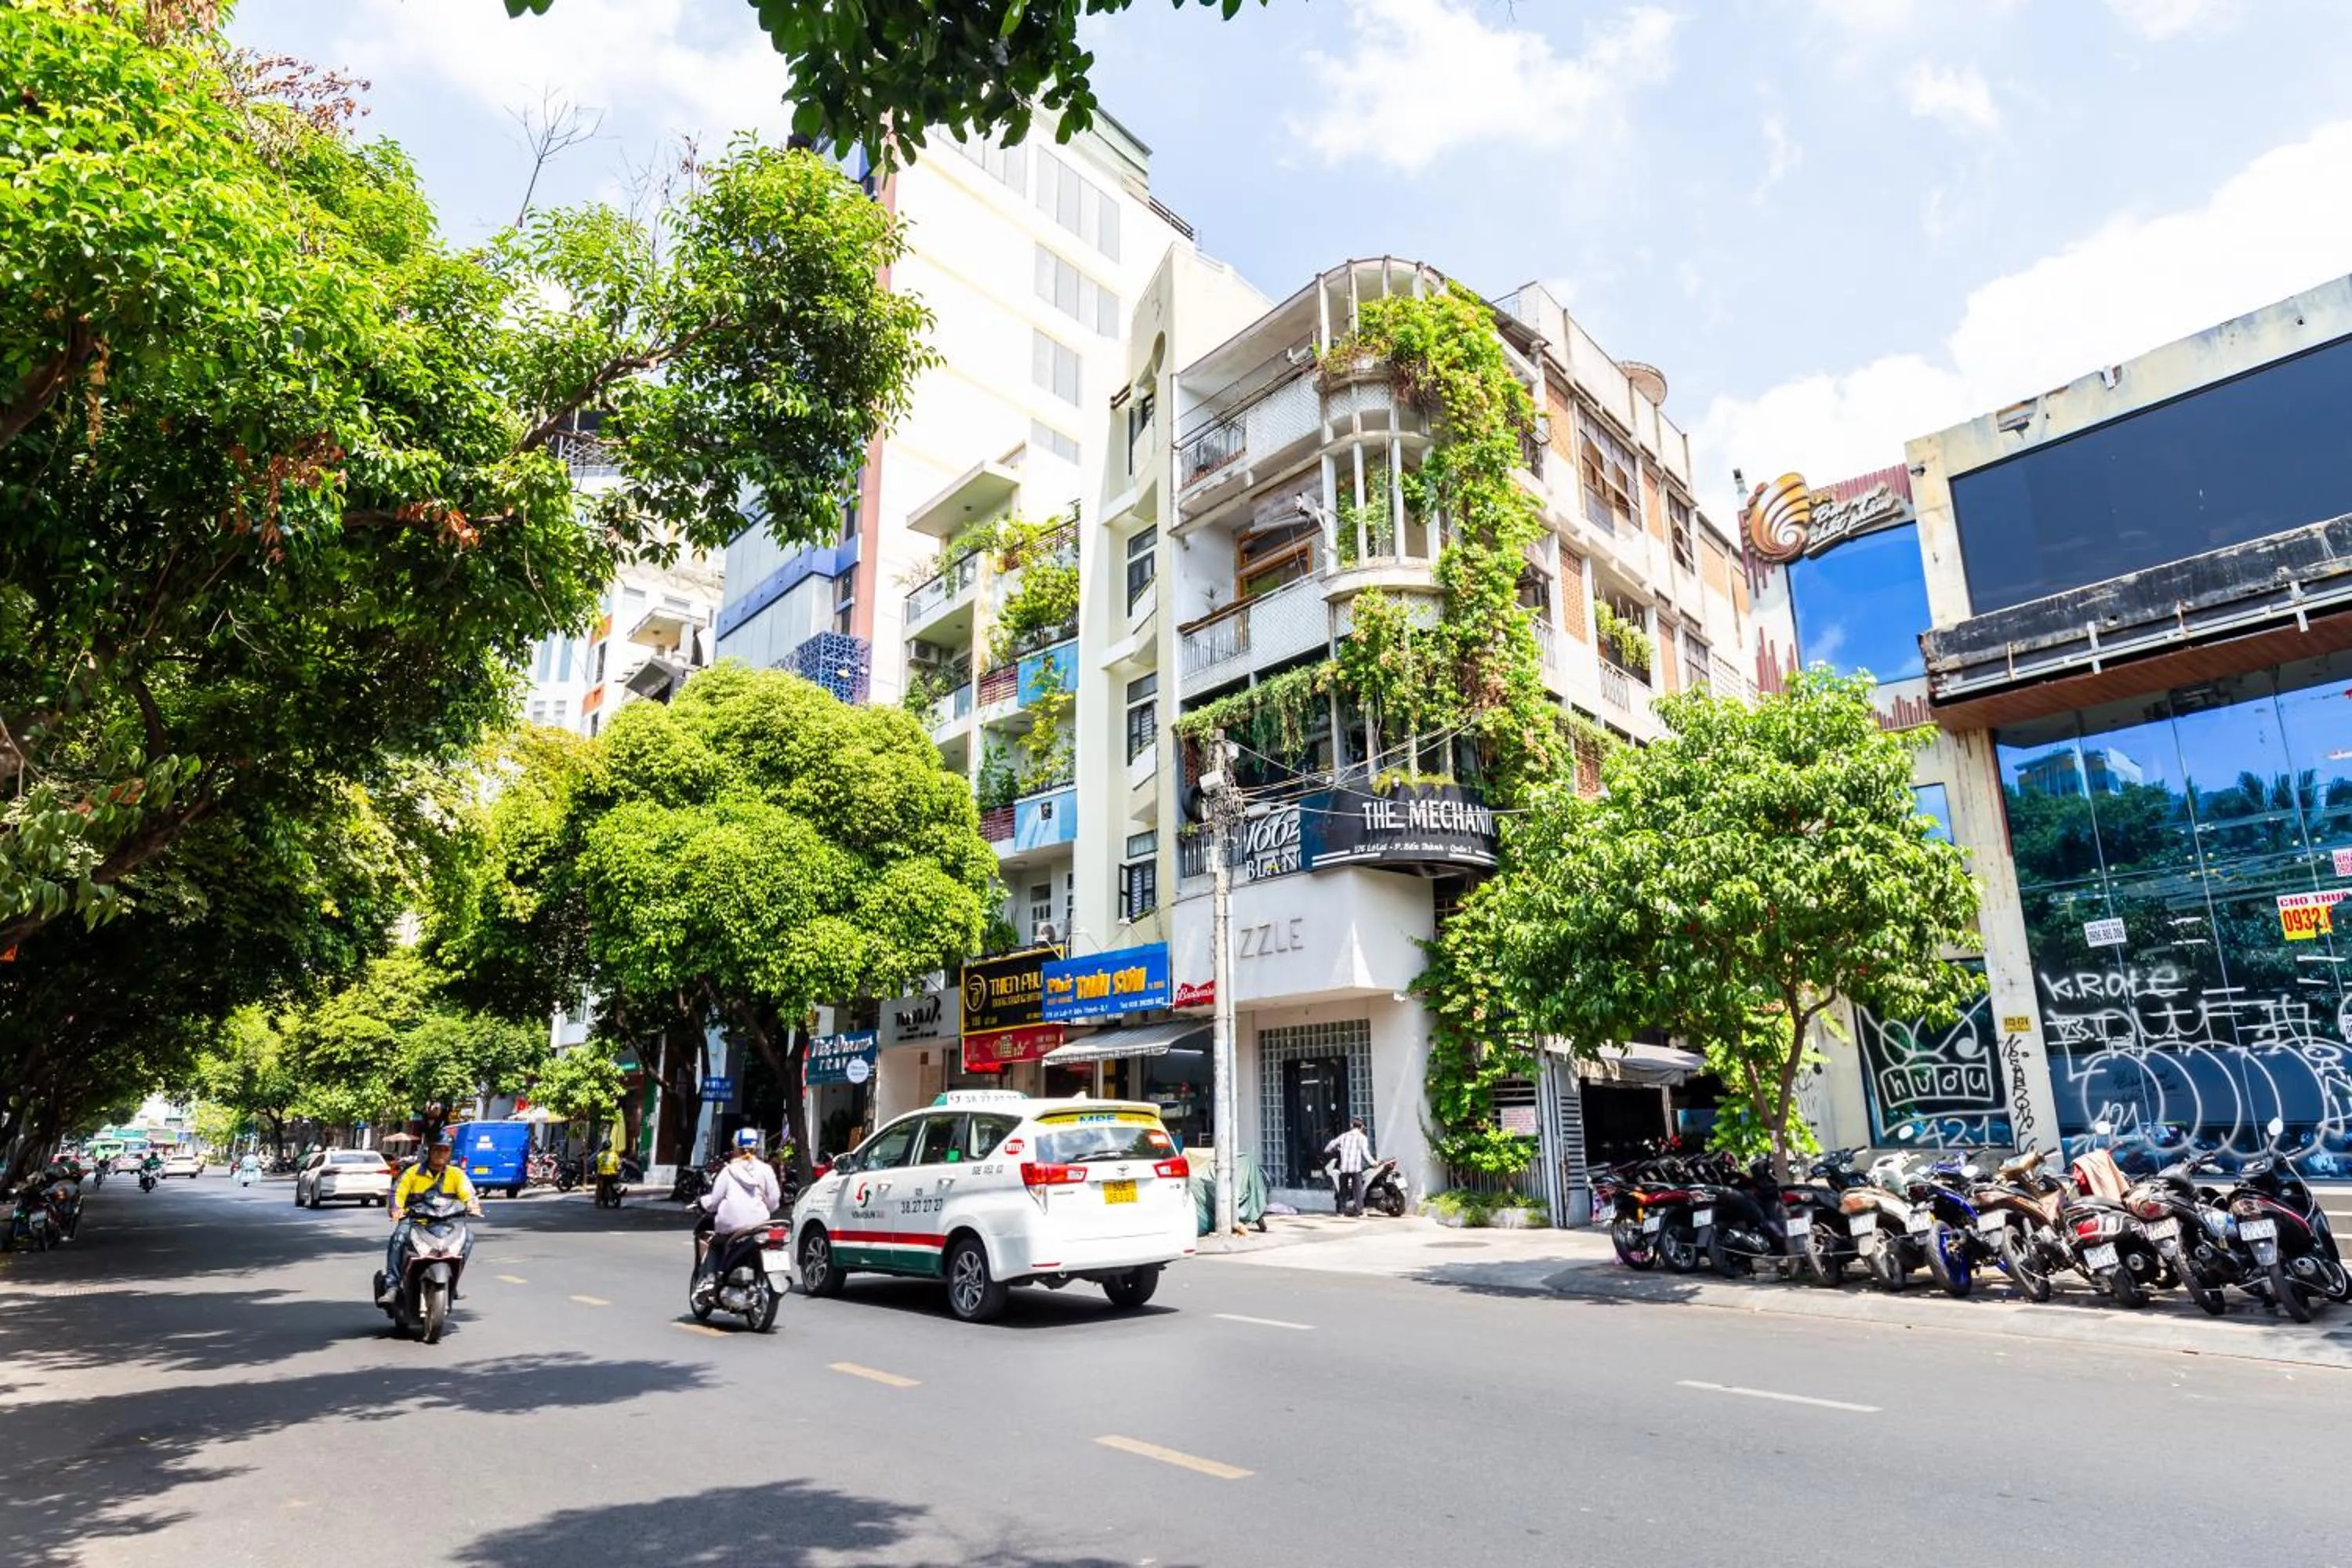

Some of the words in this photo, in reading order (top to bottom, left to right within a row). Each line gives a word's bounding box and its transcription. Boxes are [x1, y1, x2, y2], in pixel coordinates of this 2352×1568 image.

[1363, 801, 1405, 829] THE
[1247, 851, 1301, 880] BLAN
[2279, 896, 2309, 907] CHO
[1211, 918, 1305, 964] ZZLE
[818, 1054, 862, 1071] TRAV
[1915, 1114, 2001, 1151] 421
